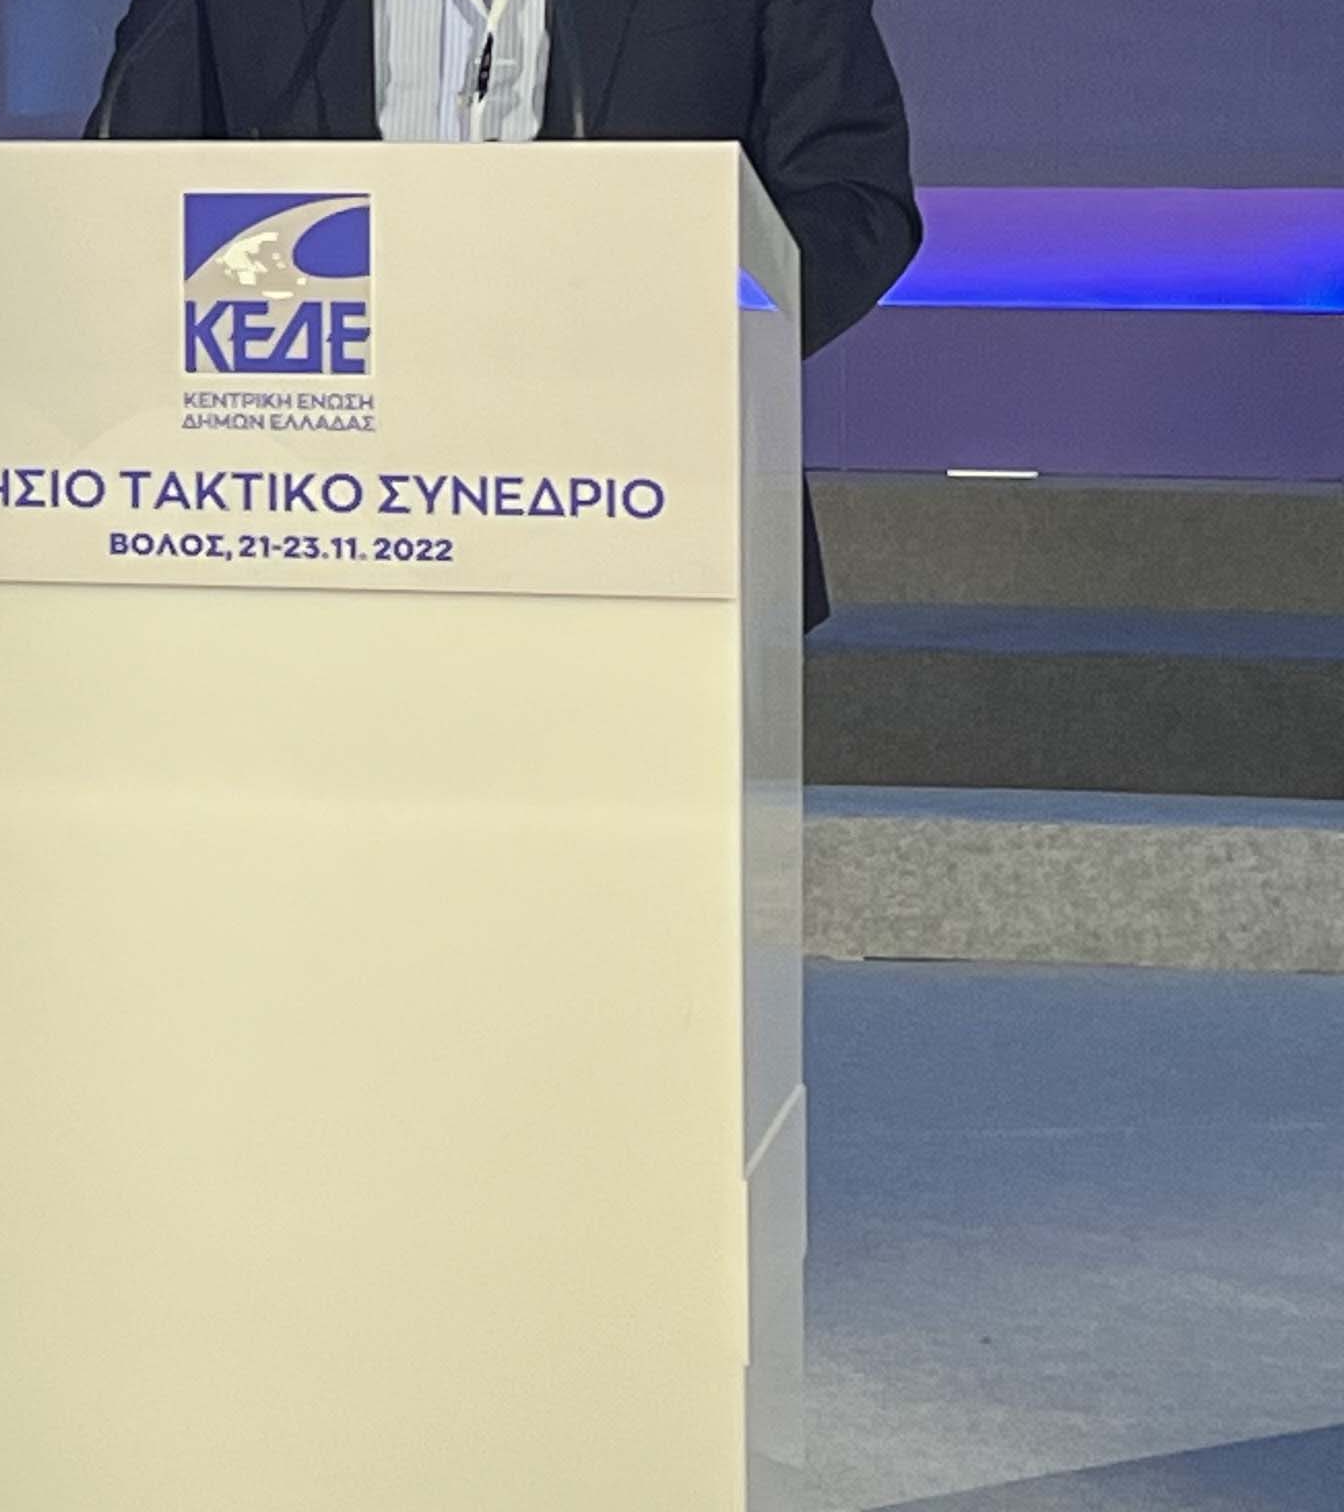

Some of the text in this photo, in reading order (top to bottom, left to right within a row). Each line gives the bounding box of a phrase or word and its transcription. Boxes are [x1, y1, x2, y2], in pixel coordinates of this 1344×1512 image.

[184, 300, 371, 374] ΚΕΔΕ
[183, 391, 375, 410] ΚΕΝΤΡΙΚΗ ΕΝΩΣΗ
[181, 414, 377, 431] ΔΗΜΩΝ ΕΛΛΑΔΑΣ
[119, 471, 364, 513] ΤΑΚΤΙΚΟ
[378, 474, 666, 519] ΣΥΝΕΔΡΙΟ
[110, 532, 454, 562] ΒΟΛΟΣ, 21-23.11. 2022
